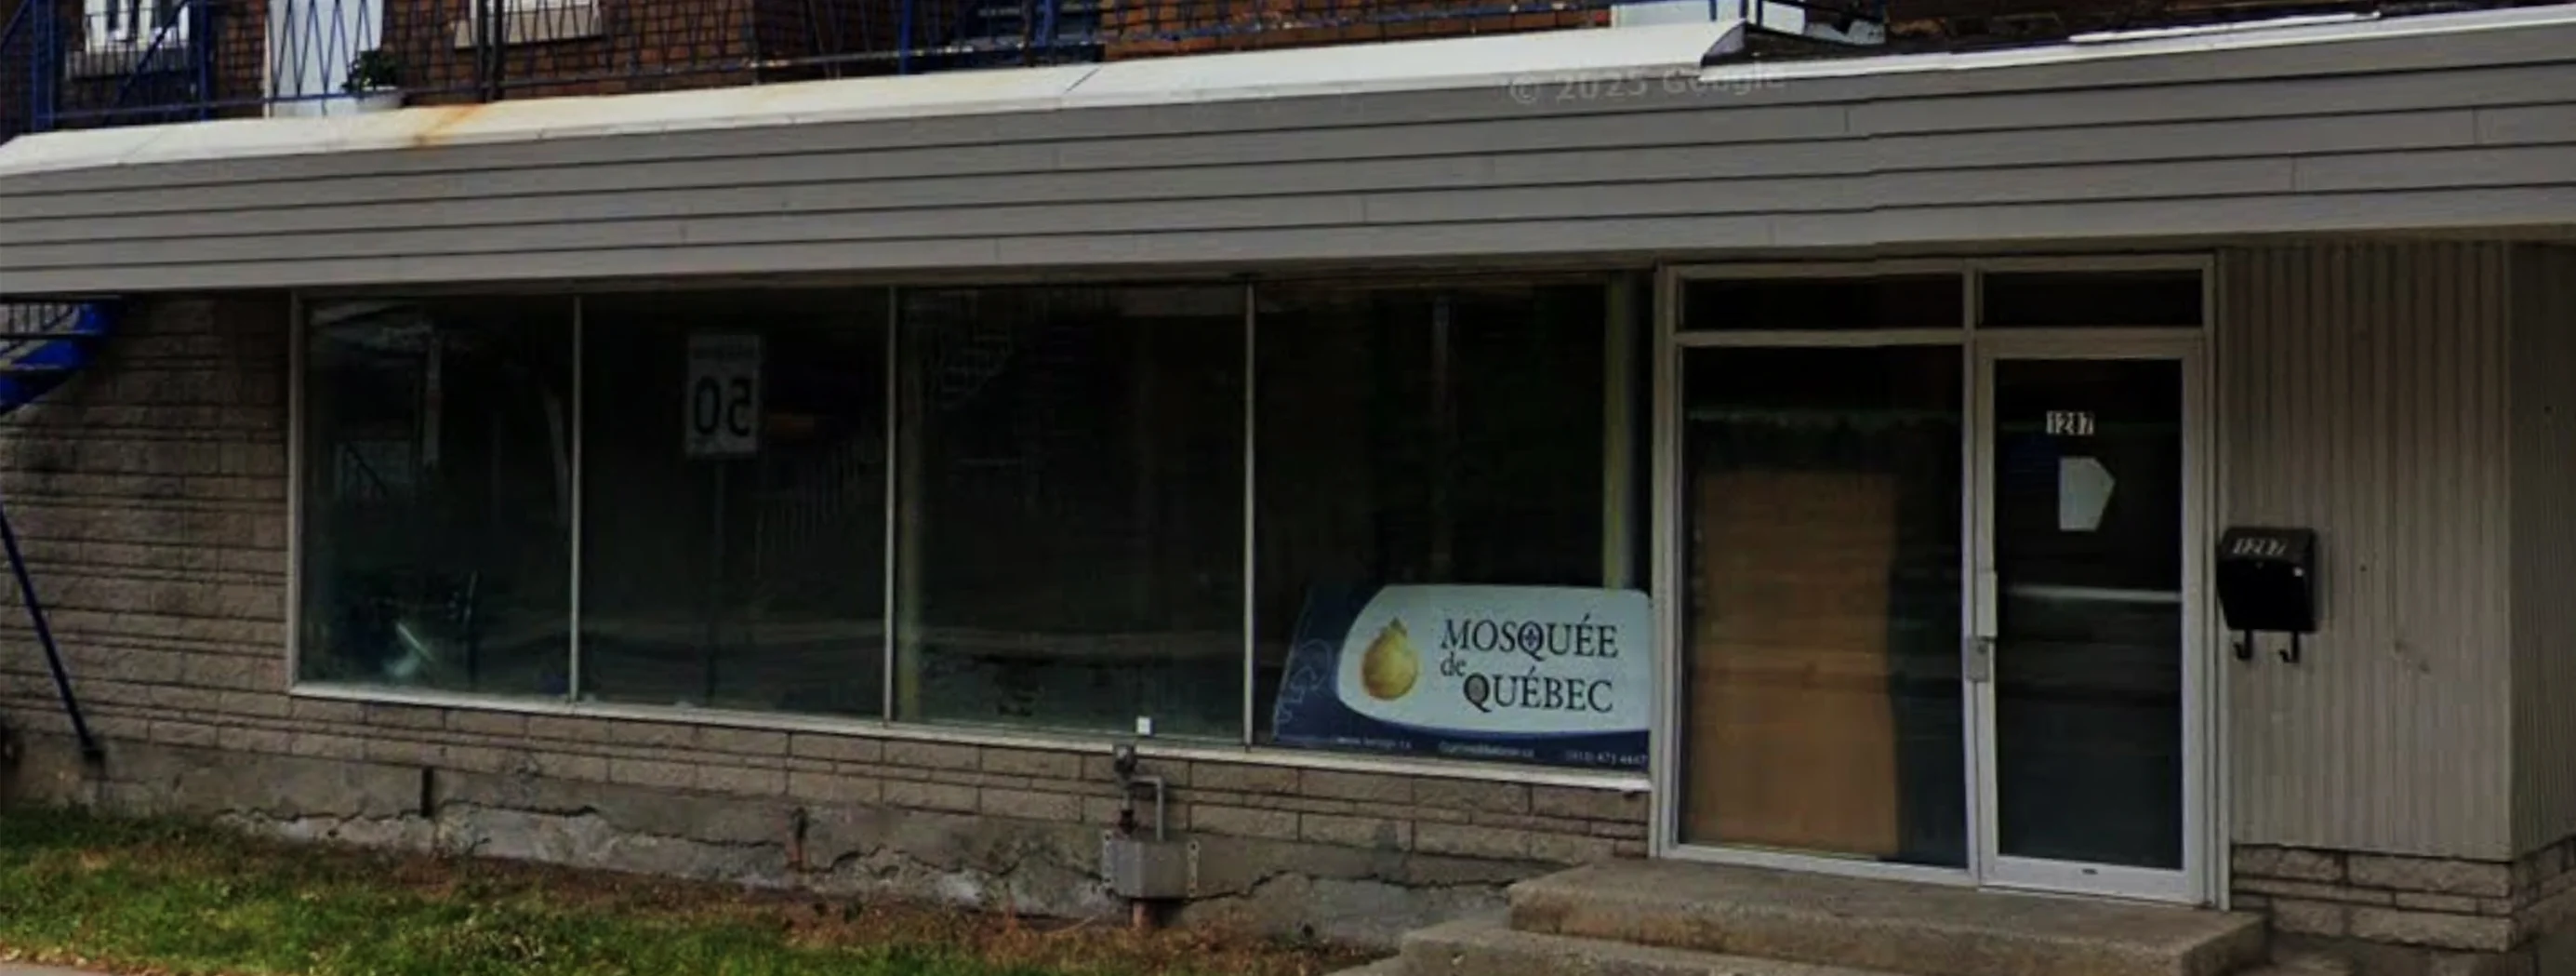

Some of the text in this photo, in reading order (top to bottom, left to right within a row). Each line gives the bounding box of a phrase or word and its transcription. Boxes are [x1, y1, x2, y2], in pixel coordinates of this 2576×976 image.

[1440, 613, 1619, 662] MOSQUÉE
[1440, 652, 1467, 678] de
[1462, 666, 1614, 714] QUÉBEC
